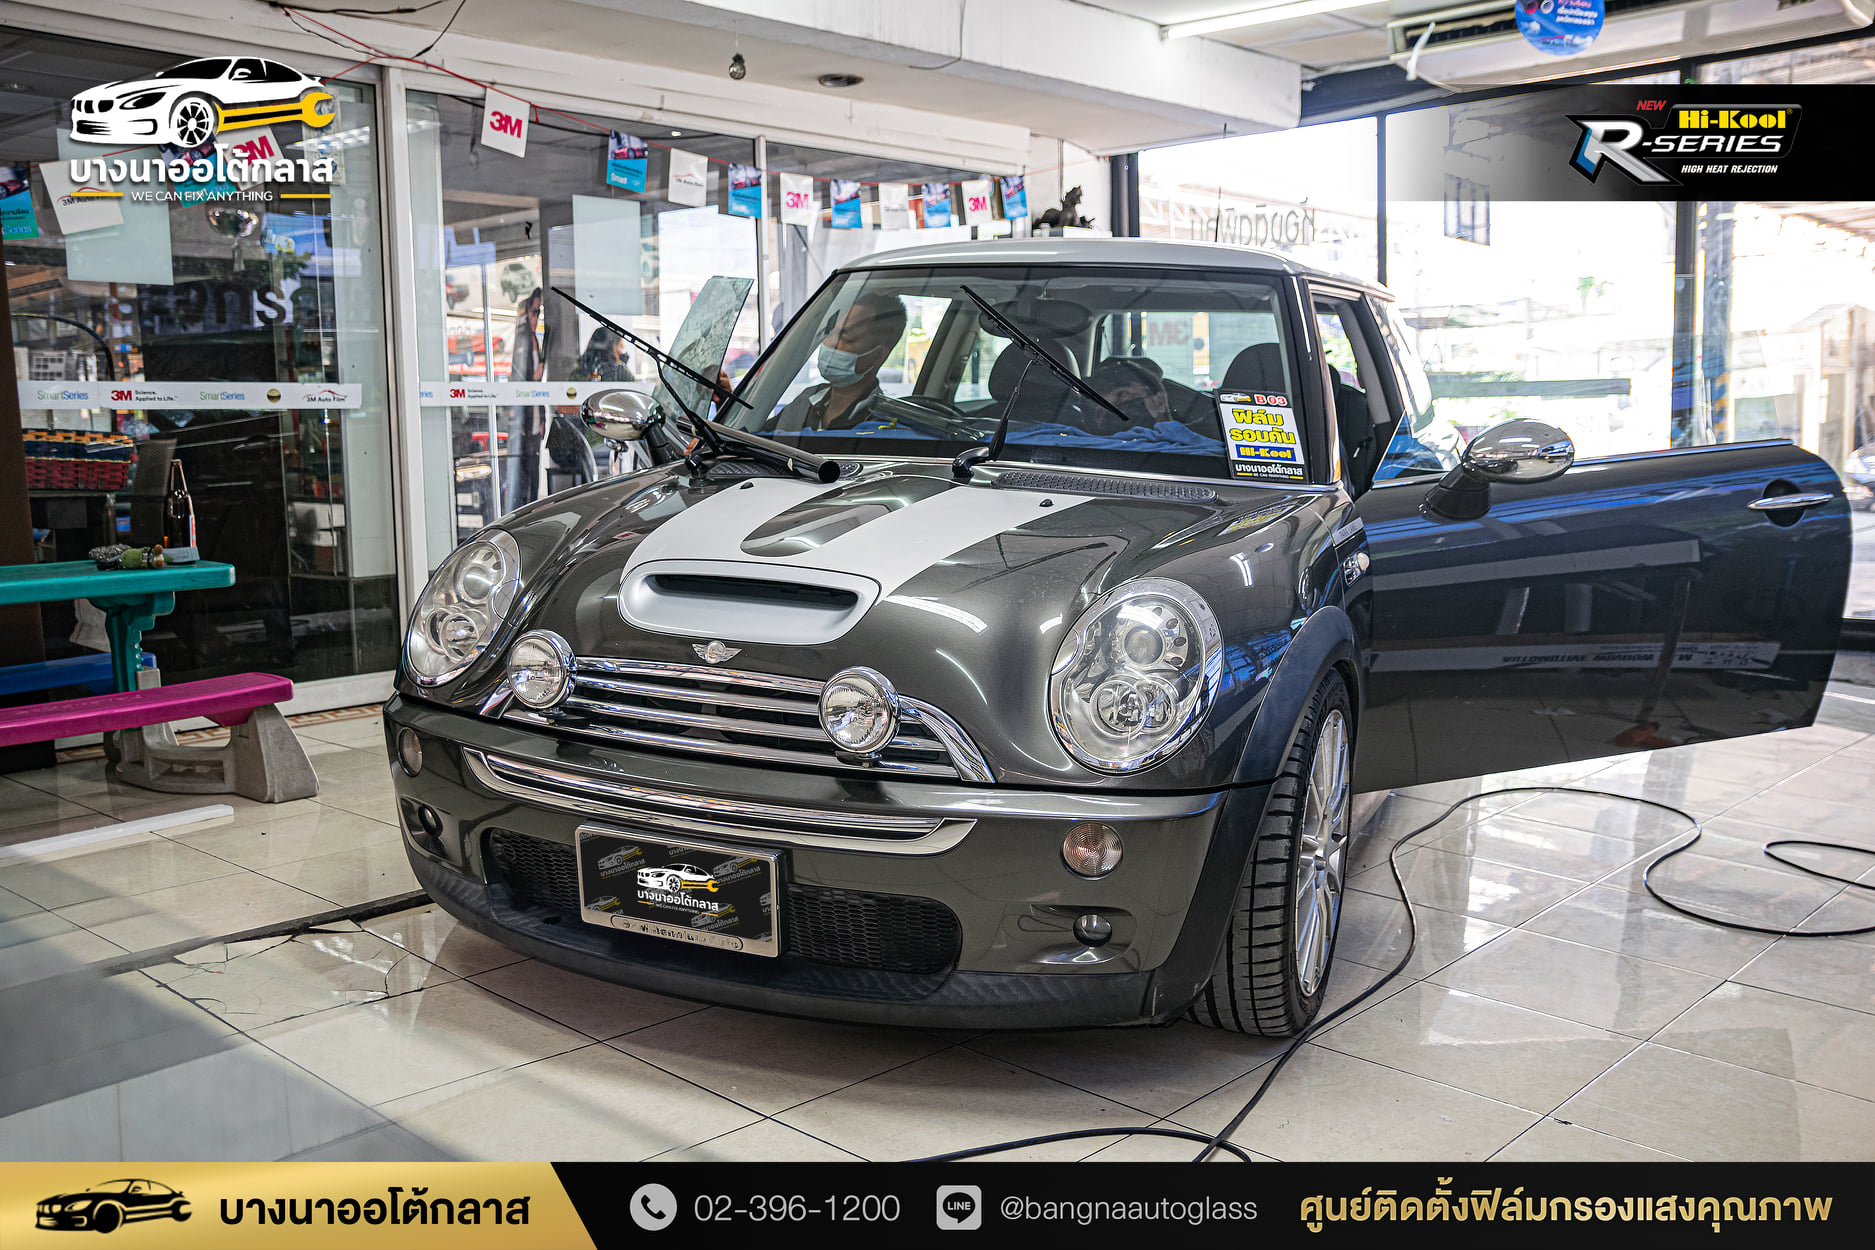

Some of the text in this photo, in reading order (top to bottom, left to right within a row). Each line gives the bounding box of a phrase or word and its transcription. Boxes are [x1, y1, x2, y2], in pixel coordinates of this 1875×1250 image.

[489, 110, 523, 138] 3M
[786, 191, 809, 210] 3M
[968, 196, 988, 213] 3M
[111, 390, 132, 401] 3M
[449, 388, 466, 399] 3M
[1232, 408, 1285, 426] ฟิล์ม
[1229, 426, 1297, 445] รอบคัน
